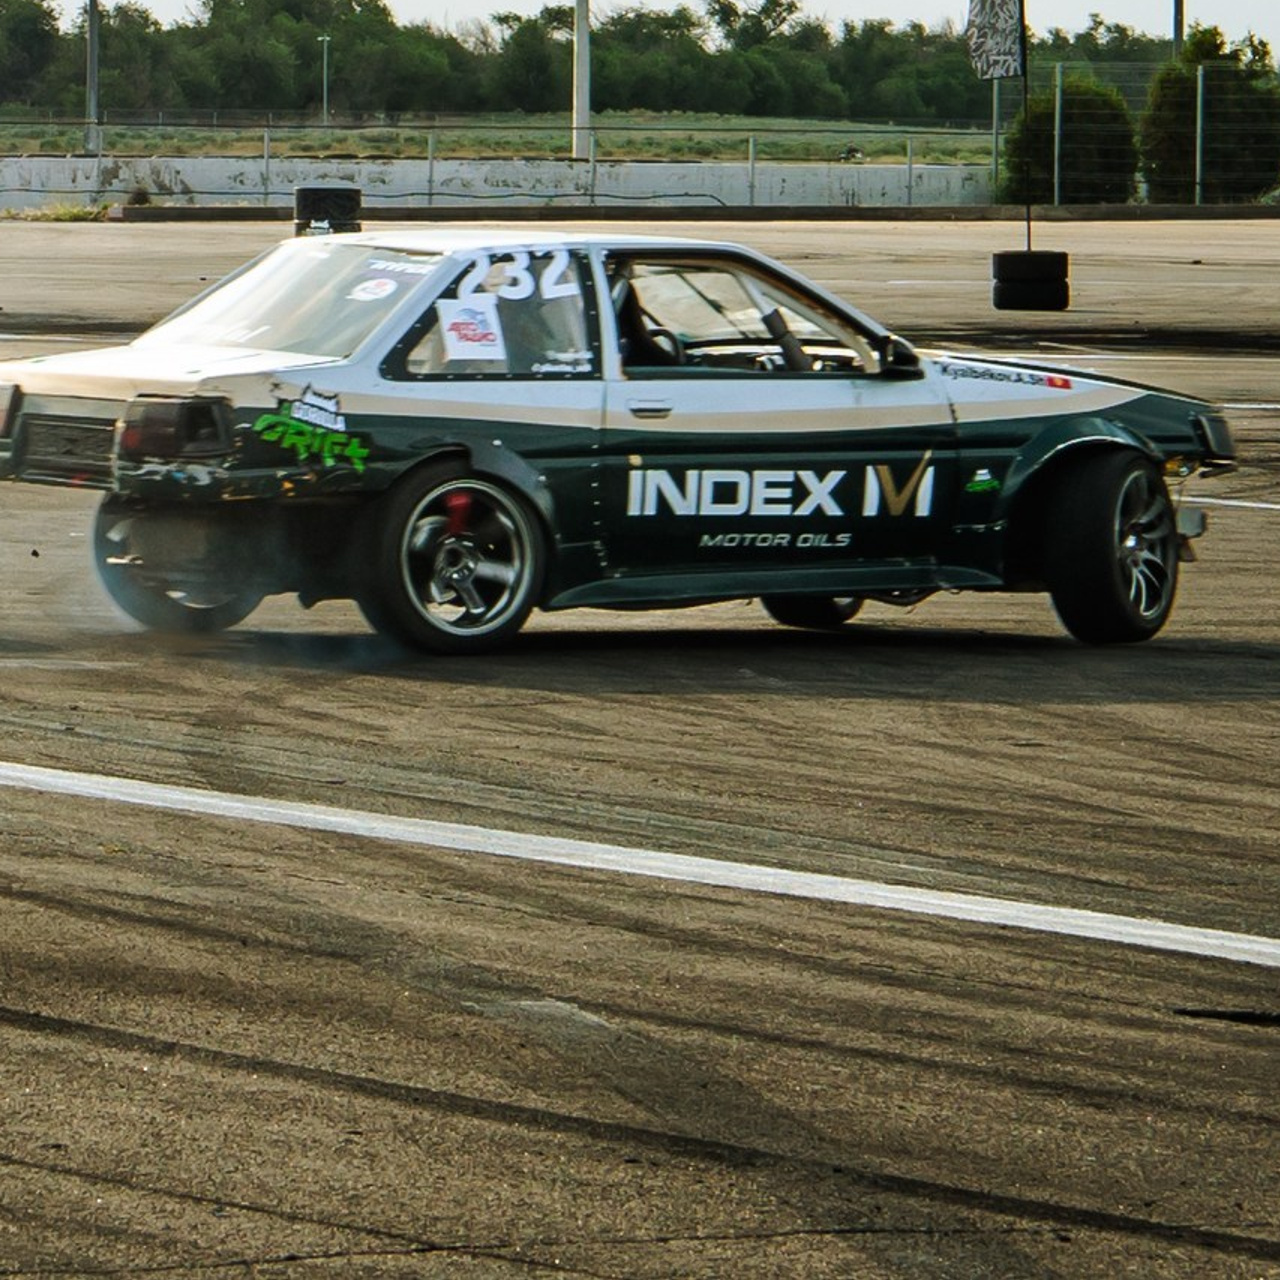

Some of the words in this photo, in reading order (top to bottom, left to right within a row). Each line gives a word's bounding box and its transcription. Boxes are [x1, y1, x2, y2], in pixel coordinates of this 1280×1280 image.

[457, 246, 581, 300] 232
[626, 455, 848, 517] INDEX
[698, 533, 791, 548] MOTOR
[795, 532, 853, 548] OILS
